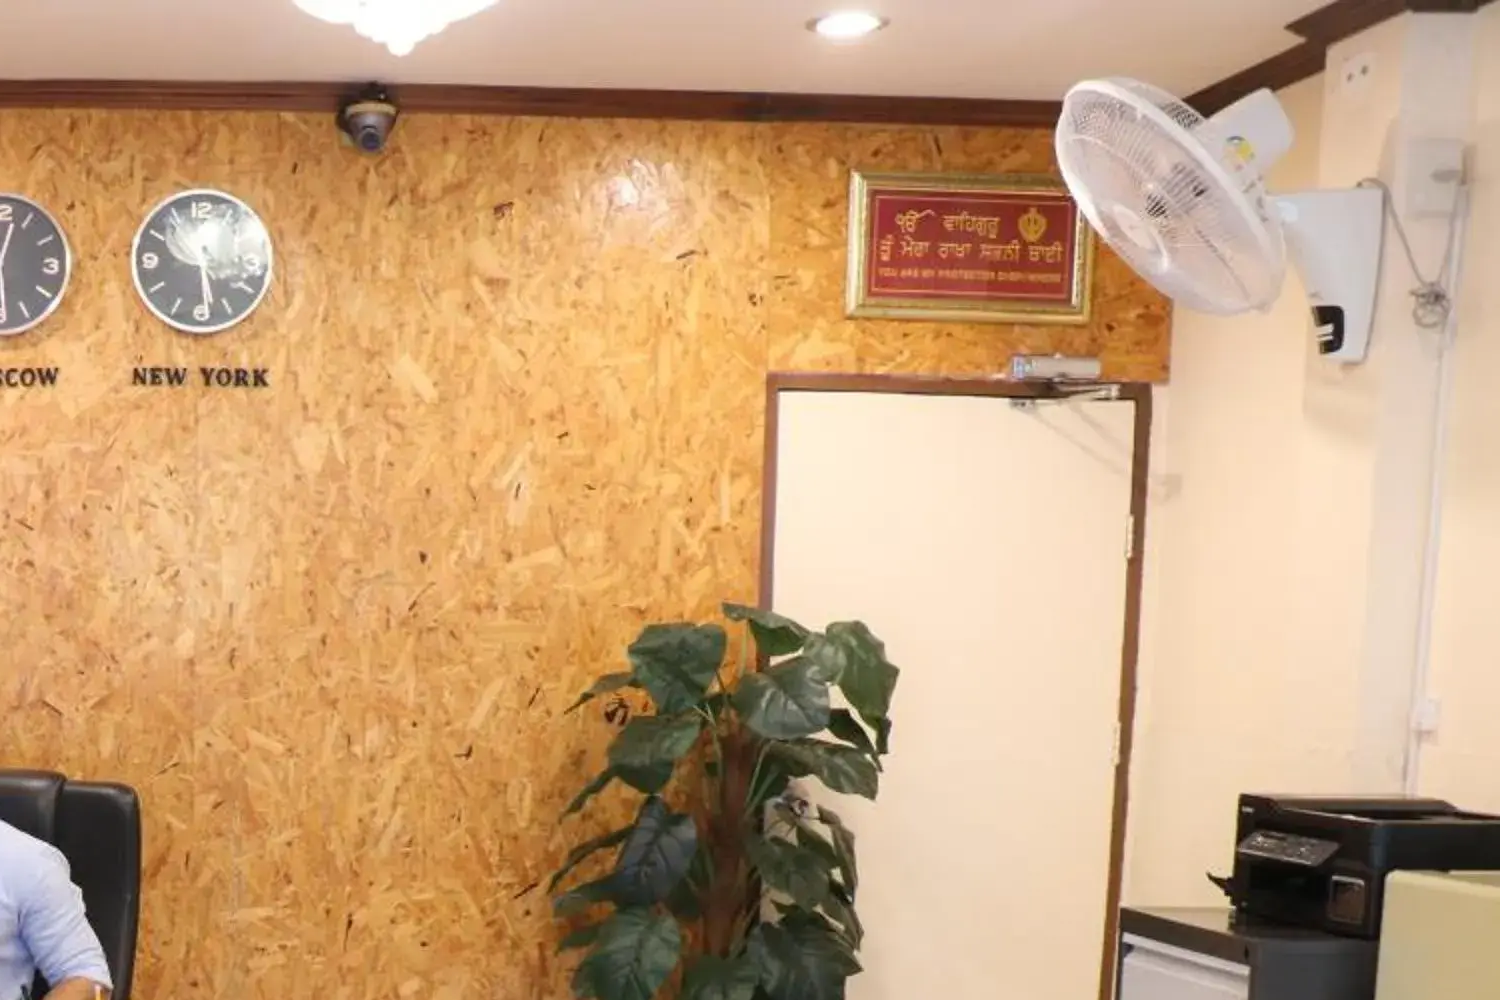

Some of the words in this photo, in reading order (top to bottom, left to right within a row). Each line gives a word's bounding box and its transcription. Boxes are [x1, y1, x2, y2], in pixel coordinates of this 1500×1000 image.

[190, 201, 212, 219] 12
[43, 257, 59, 275] 3
[142, 252, 159, 270] 9
[132, 367, 187, 388] NEW
[200, 367, 270, 389] YORK
